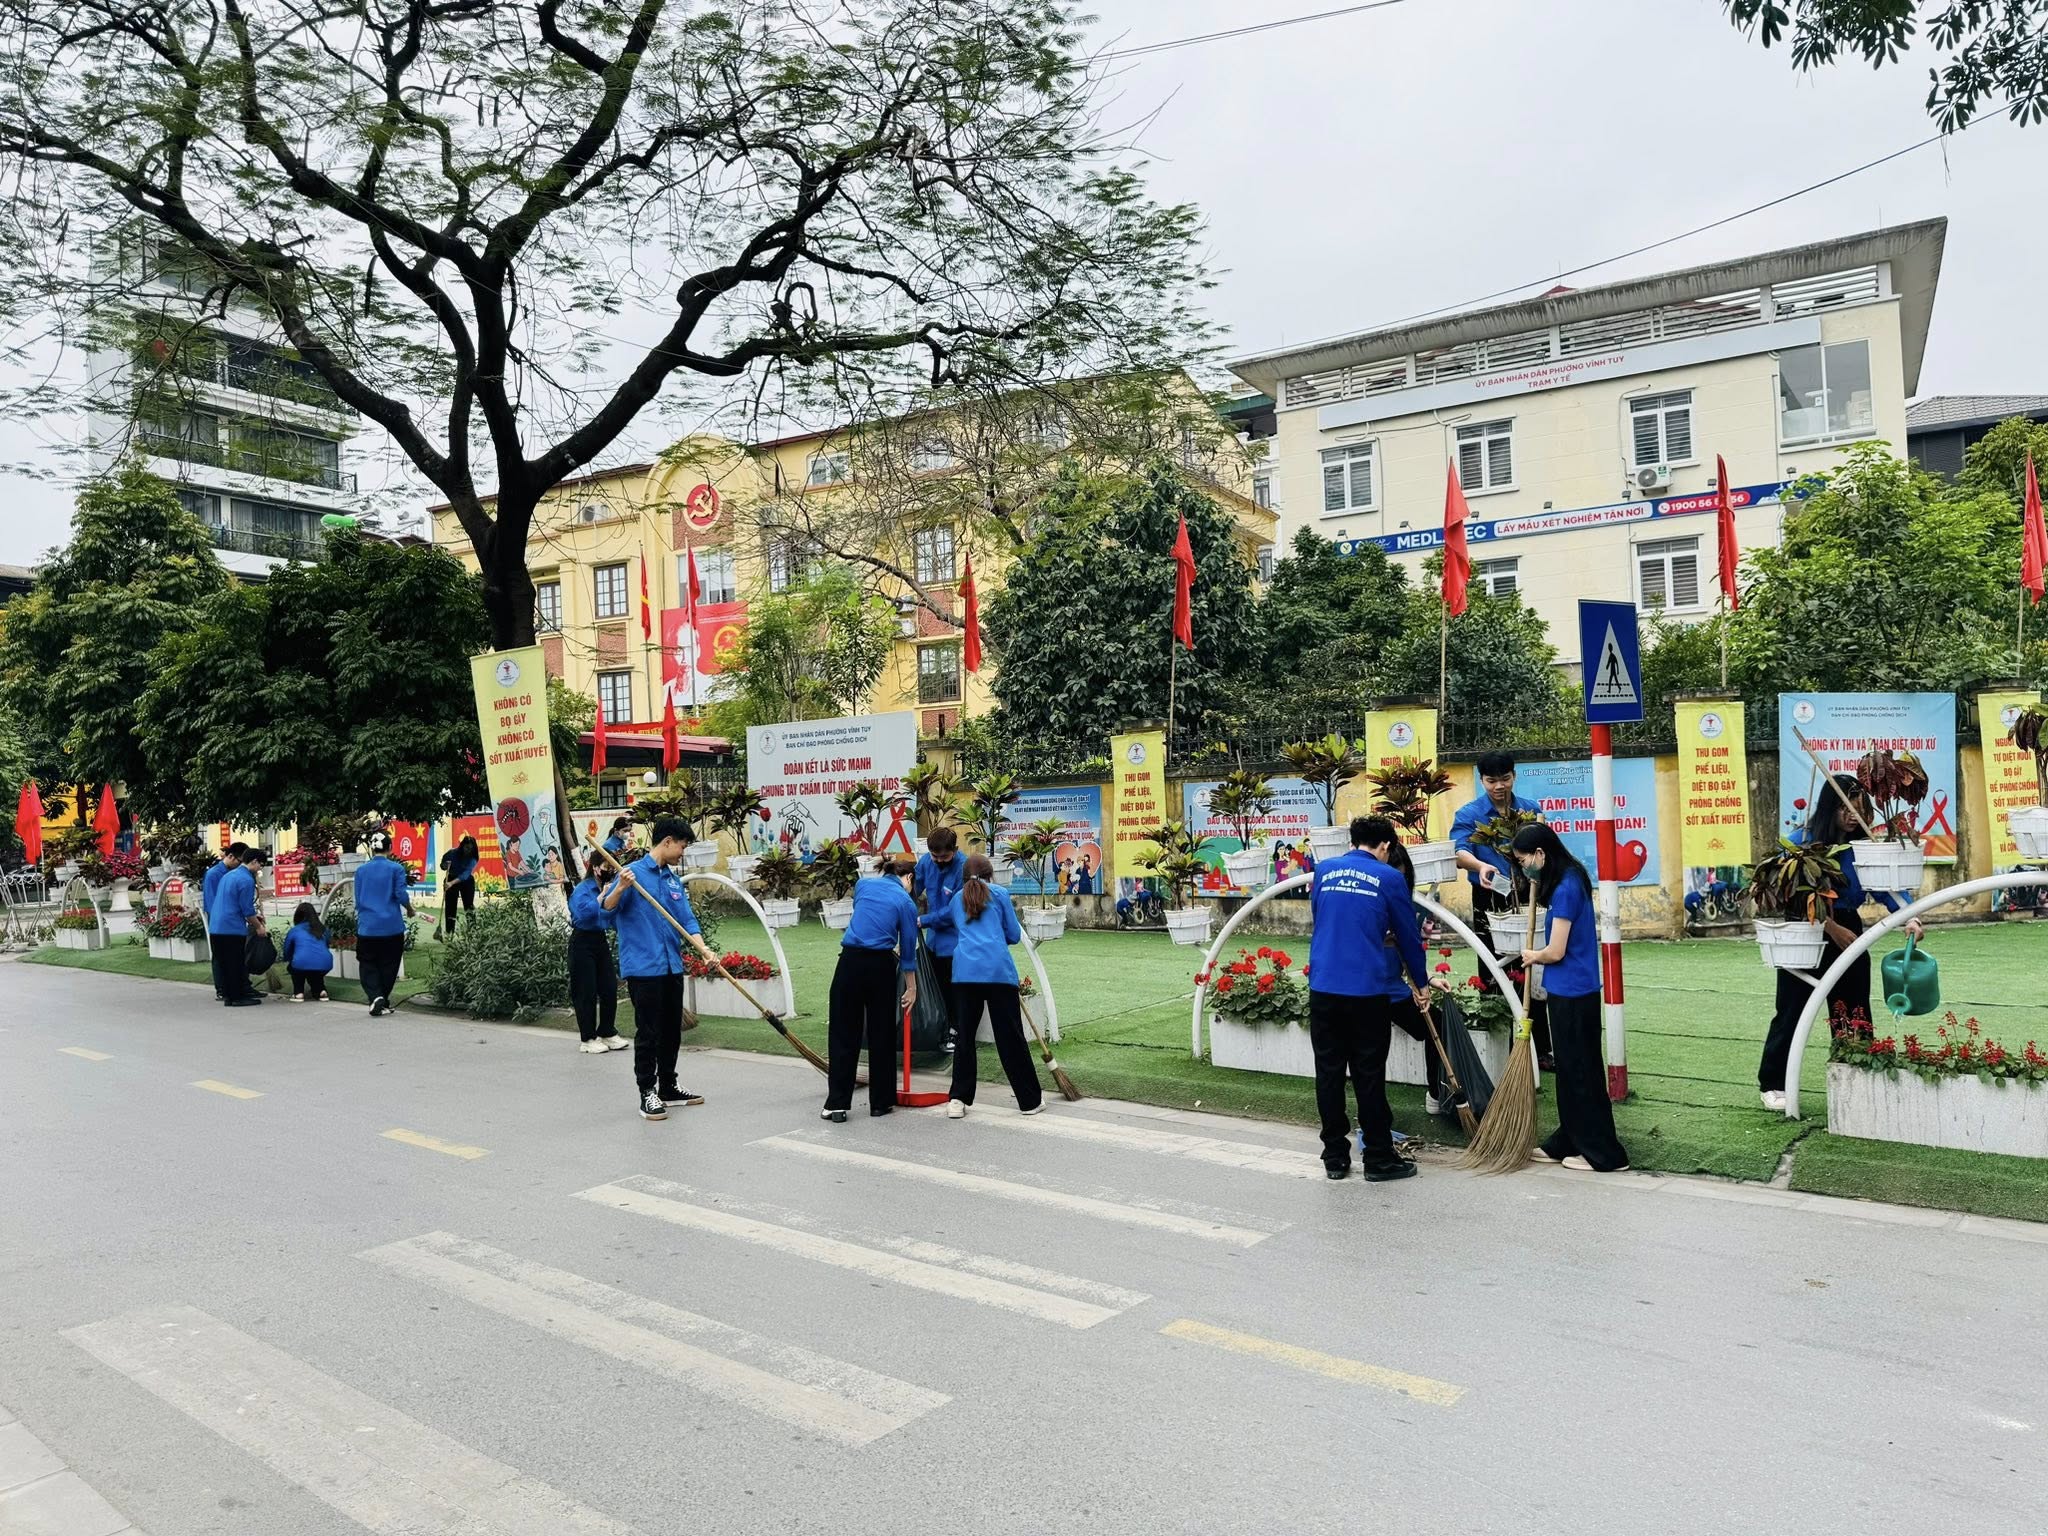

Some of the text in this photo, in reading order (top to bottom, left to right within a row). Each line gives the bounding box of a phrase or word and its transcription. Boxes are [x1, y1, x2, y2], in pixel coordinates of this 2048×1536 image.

[1488, 376, 1506, 386] BAN
[1506, 372, 1529, 383] NHÂN
[1530, 370, 1548, 380] DÂN
[1550, 362, 1584, 375] PHƯỜNG
[1585, 359, 1606, 368] VĨNH
[1608, 356, 1625, 364] TUY
[1528, 378, 1550, 389] TRẠM
[1560, 374, 1570, 382] TẾ
[1670, 500, 1696, 511] 1900
[1698, 498, 1712, 508] 56
[1497, 522, 1514, 534] LẤY
[1563, 512, 1601, 526] NGHIỆM
[1604, 510, 1623, 521] TẬN
[1626, 506, 1644, 516] NƠI
[1397, 525, 1486, 550] MEDLEC
[494, 693, 532, 711] KHÔNG CÓ
[500, 716, 511, 728] BỌ
[497, 728, 534, 746] KHÔNG CÓ
[1857, 736, 1866, 750] VÀ
[1910, 736, 1922, 750] ĐỐI
[489, 750, 504, 765] SỐT
[1696, 747, 1728, 758] THU GOM
[784, 756, 872, 776] ĐOÀN KẾT LÀ SỨC MẠNH
[1696, 762, 1710, 774] PHẾ
[1124, 772, 1150, 782] THU GOM
[760, 784, 785, 798] CHUNG
[786, 783, 798, 796] TAY
[800, 778, 820, 795] CHẤM
[822, 779, 836, 794] DỨT
[1124, 786, 1136, 796] PHẾ
[1692, 778, 1736, 794] DIỆT BỌ GẬY
[1136, 802, 1144, 812] BỌ
[1538, 795, 1566, 812] TÂM
[1690, 794, 1742, 808] PHÒNG CHỐNG
[1993, 796, 2004, 808] SỐT
[1118, 812, 1160, 826] PHÒNG CHỐNG
[1686, 810, 1746, 826] SỐT XUẤT HUYẾT
[1116, 830, 1127, 841] SỐT
[1338, 880, 1360, 888] AJC
